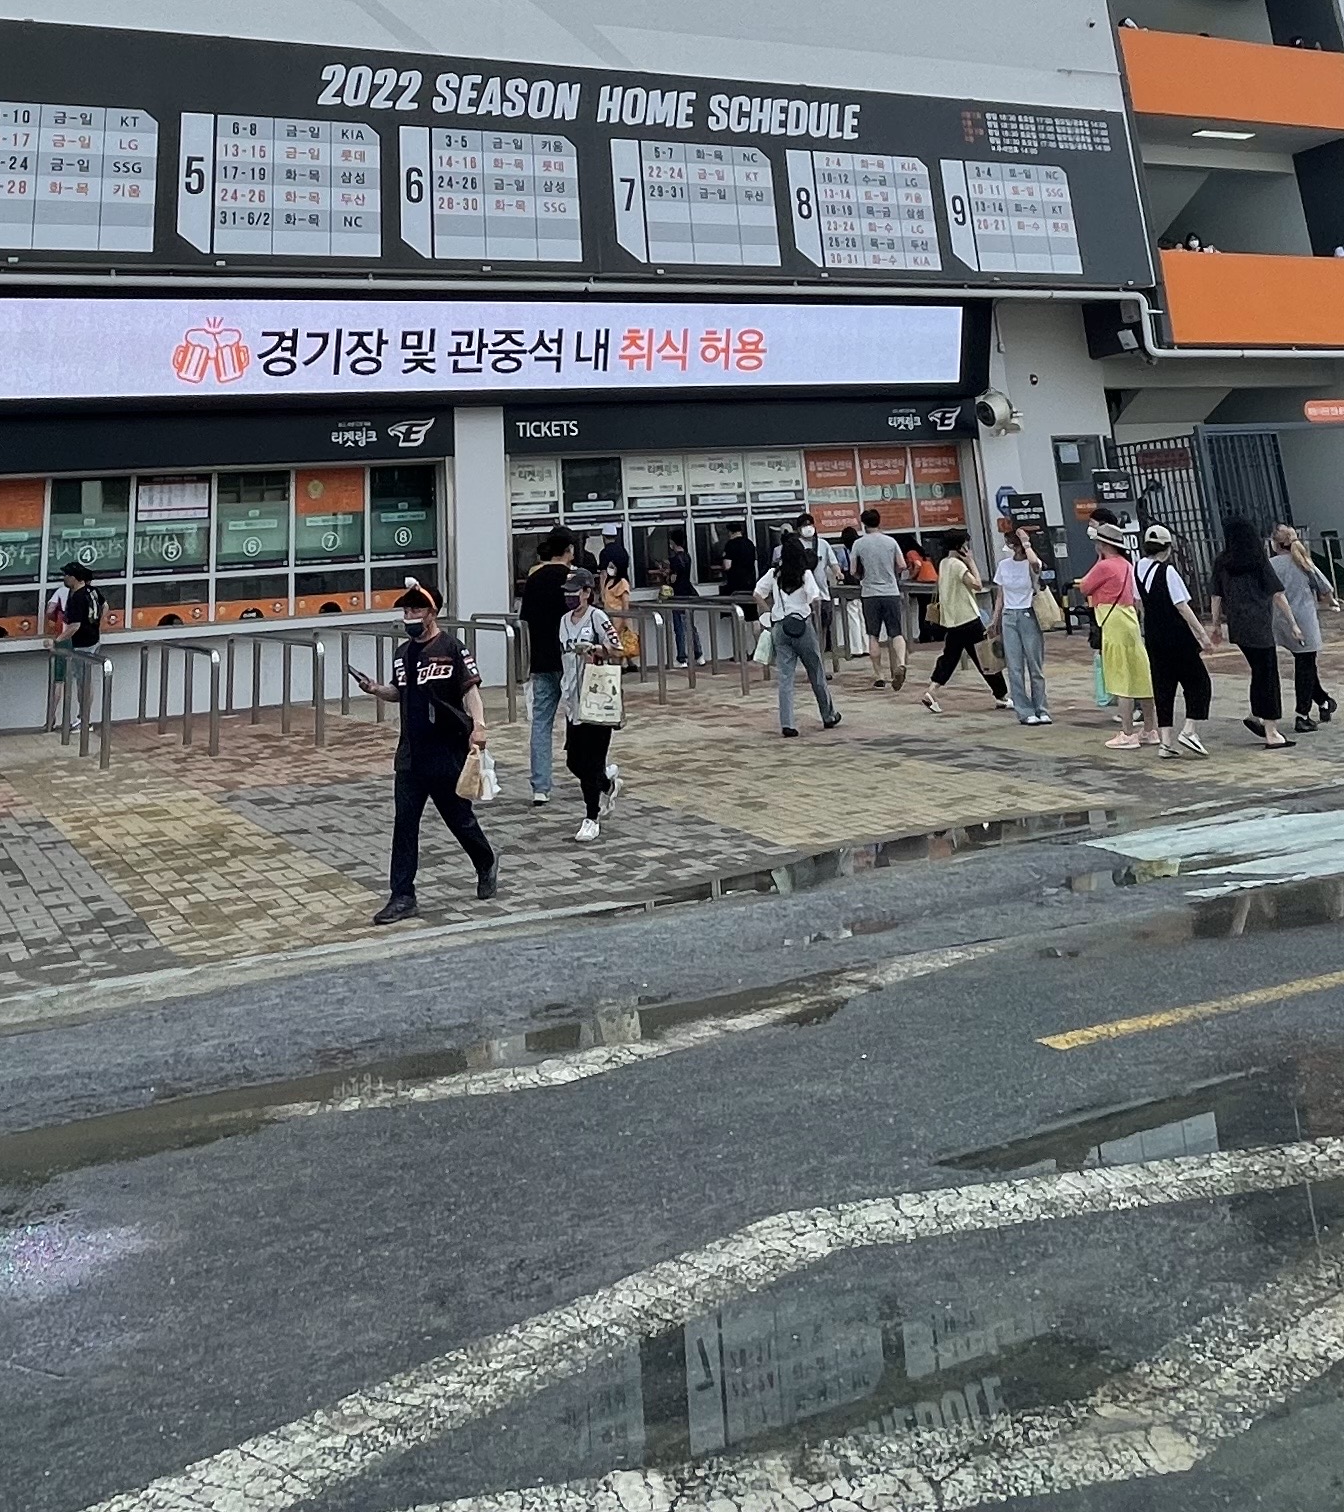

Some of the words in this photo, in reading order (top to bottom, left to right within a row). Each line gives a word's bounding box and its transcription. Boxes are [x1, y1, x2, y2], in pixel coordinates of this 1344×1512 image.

[317, 63, 422, 111] 2022
[432, 72, 581, 122] SEASON
[597, 85, 697, 129] HOME
[707, 93, 861, 141] SCHEDULE
[54, 111, 92, 126] 금-일
[120, 116, 139, 127] KT
[233, 122, 256, 135] 6-8
[286, 125, 320, 138] 금-일
[341, 129, 364, 140] KIA
[119, 139, 138, 150] LG
[224, 144, 266, 158] 13-15
[446, 135, 467, 148] 3-5
[541, 140, 563, 152] 키움
[654, 147, 673, 159] 5-7
[743, 153, 758, 162] NC
[50, 158, 89, 172] 금-일
[113, 162, 142, 173] SSG
[648, 166, 683, 179] 22-24
[745, 172, 758, 181] KT
[901, 162, 917, 171] KIA
[185, 156, 204, 194] 5
[223, 166, 266, 180] 17-19
[341, 172, 365, 184] 삼성
[905, 179, 918, 187] LG
[1045, 171, 1058, 180] NC
[113, 185, 140, 197] 키움
[406, 167, 423, 203] 6
[438, 176, 477, 189] 24-26
[543, 180, 565, 193] 삼성
[650, 185, 683, 198] 29-31
[221, 189, 265, 203] 24-26
[341, 194, 365, 206] 두산
[620, 178, 635, 211] 7
[1046, 189, 1063, 198] SSG
[439, 197, 477, 210] 28-30
[544, 202, 566, 213] SSG
[797, 187, 812, 219] 8
[952, 195, 966, 226] 9
[220, 212, 270, 225] 31-6/2
[344, 217, 362, 227] NC
[911, 226, 924, 234] LG
[913, 257, 930, 265] KIA
[257, 328, 389, 376] 경기장
[398, 328, 437, 373] 및
[447, 326, 566, 374] 관중석
[574, 327, 610, 372] 내
[619, 327, 691, 371] 취식
[699, 326, 768, 372] 허용
[516, 419, 579, 439] TICKETS
